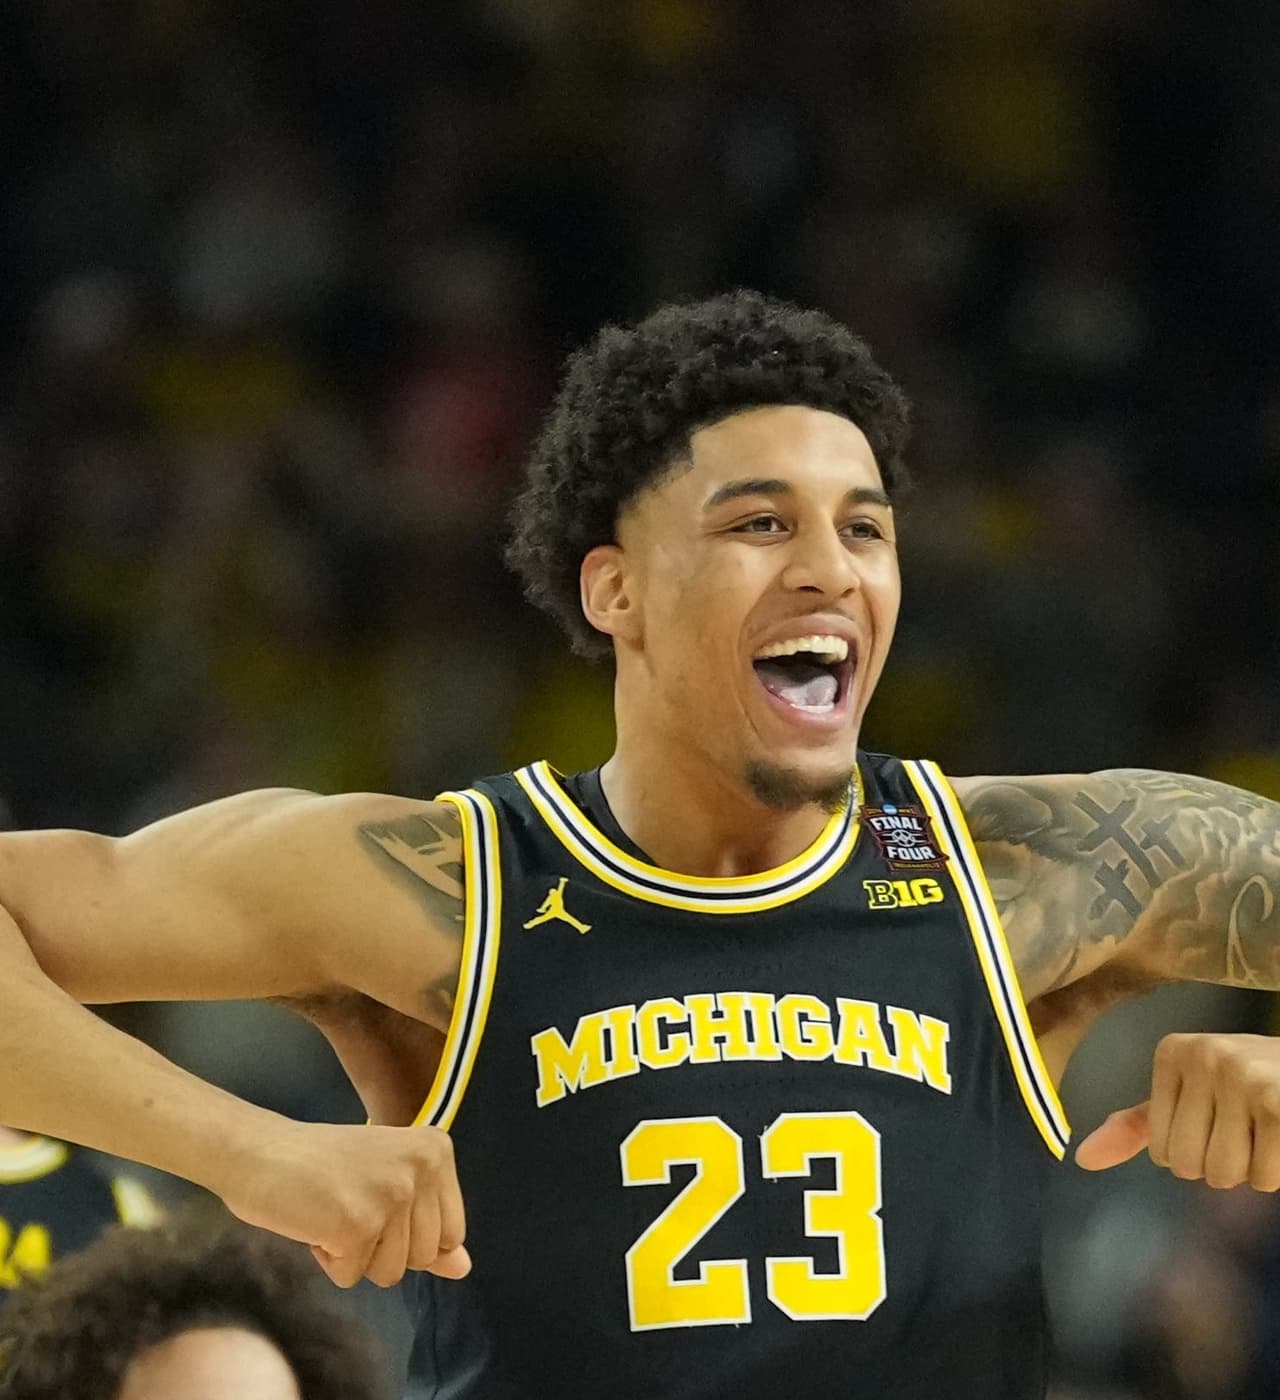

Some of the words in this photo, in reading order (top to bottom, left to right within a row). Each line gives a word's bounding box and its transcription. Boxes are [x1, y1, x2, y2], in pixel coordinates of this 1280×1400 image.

[869, 815, 923, 831] FINAL
[886, 846, 937, 860] FOUR
[531, 991, 952, 1108] MICHIGAN
[620, 1111, 887, 1332] 23
